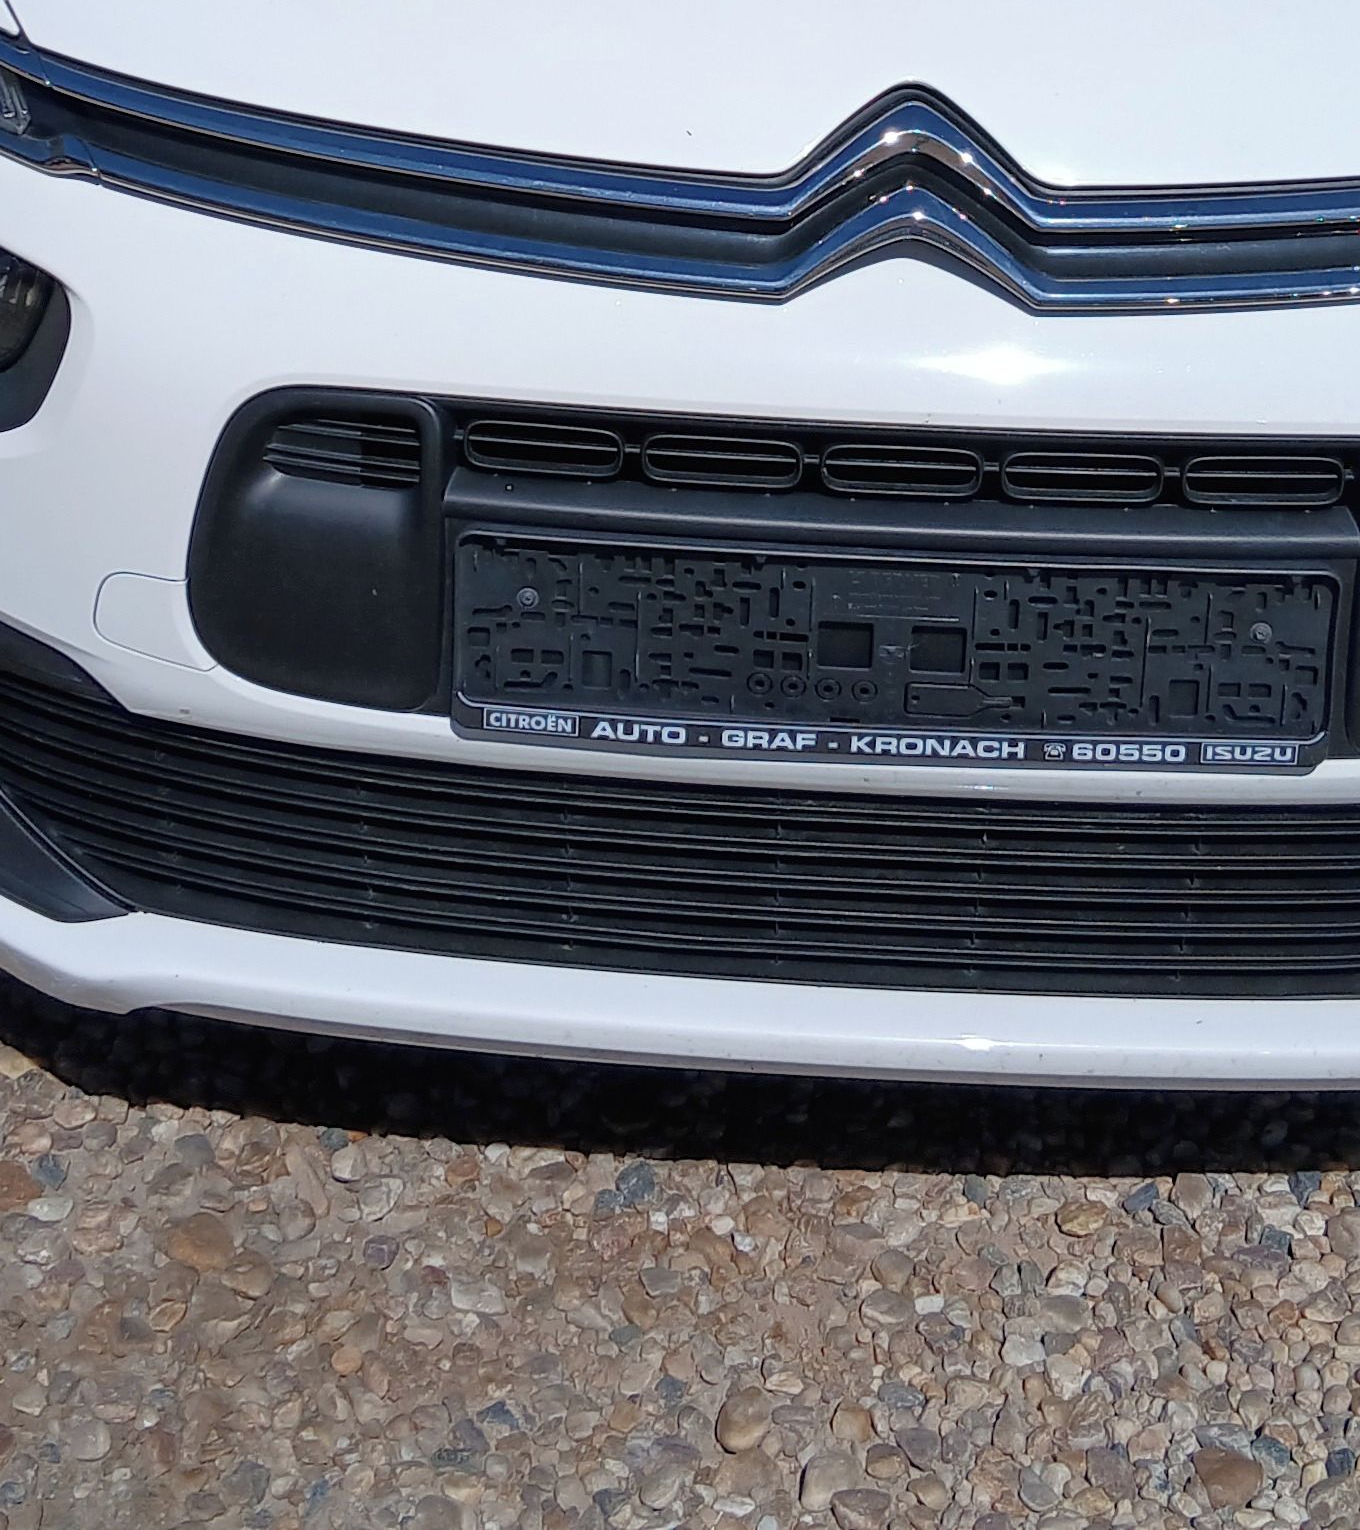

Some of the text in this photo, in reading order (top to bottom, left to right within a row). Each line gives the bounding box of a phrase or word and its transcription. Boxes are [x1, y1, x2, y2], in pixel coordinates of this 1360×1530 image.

[489, 711, 573, 733] CITROËN
[591, 721, 686, 744] AUTO
[721, 729, 817, 751] GRAF
[850, 735, 1025, 759] KRONACH
[1072, 743, 1186, 762] 60550
[1205, 745, 1292, 761] ISUZU
